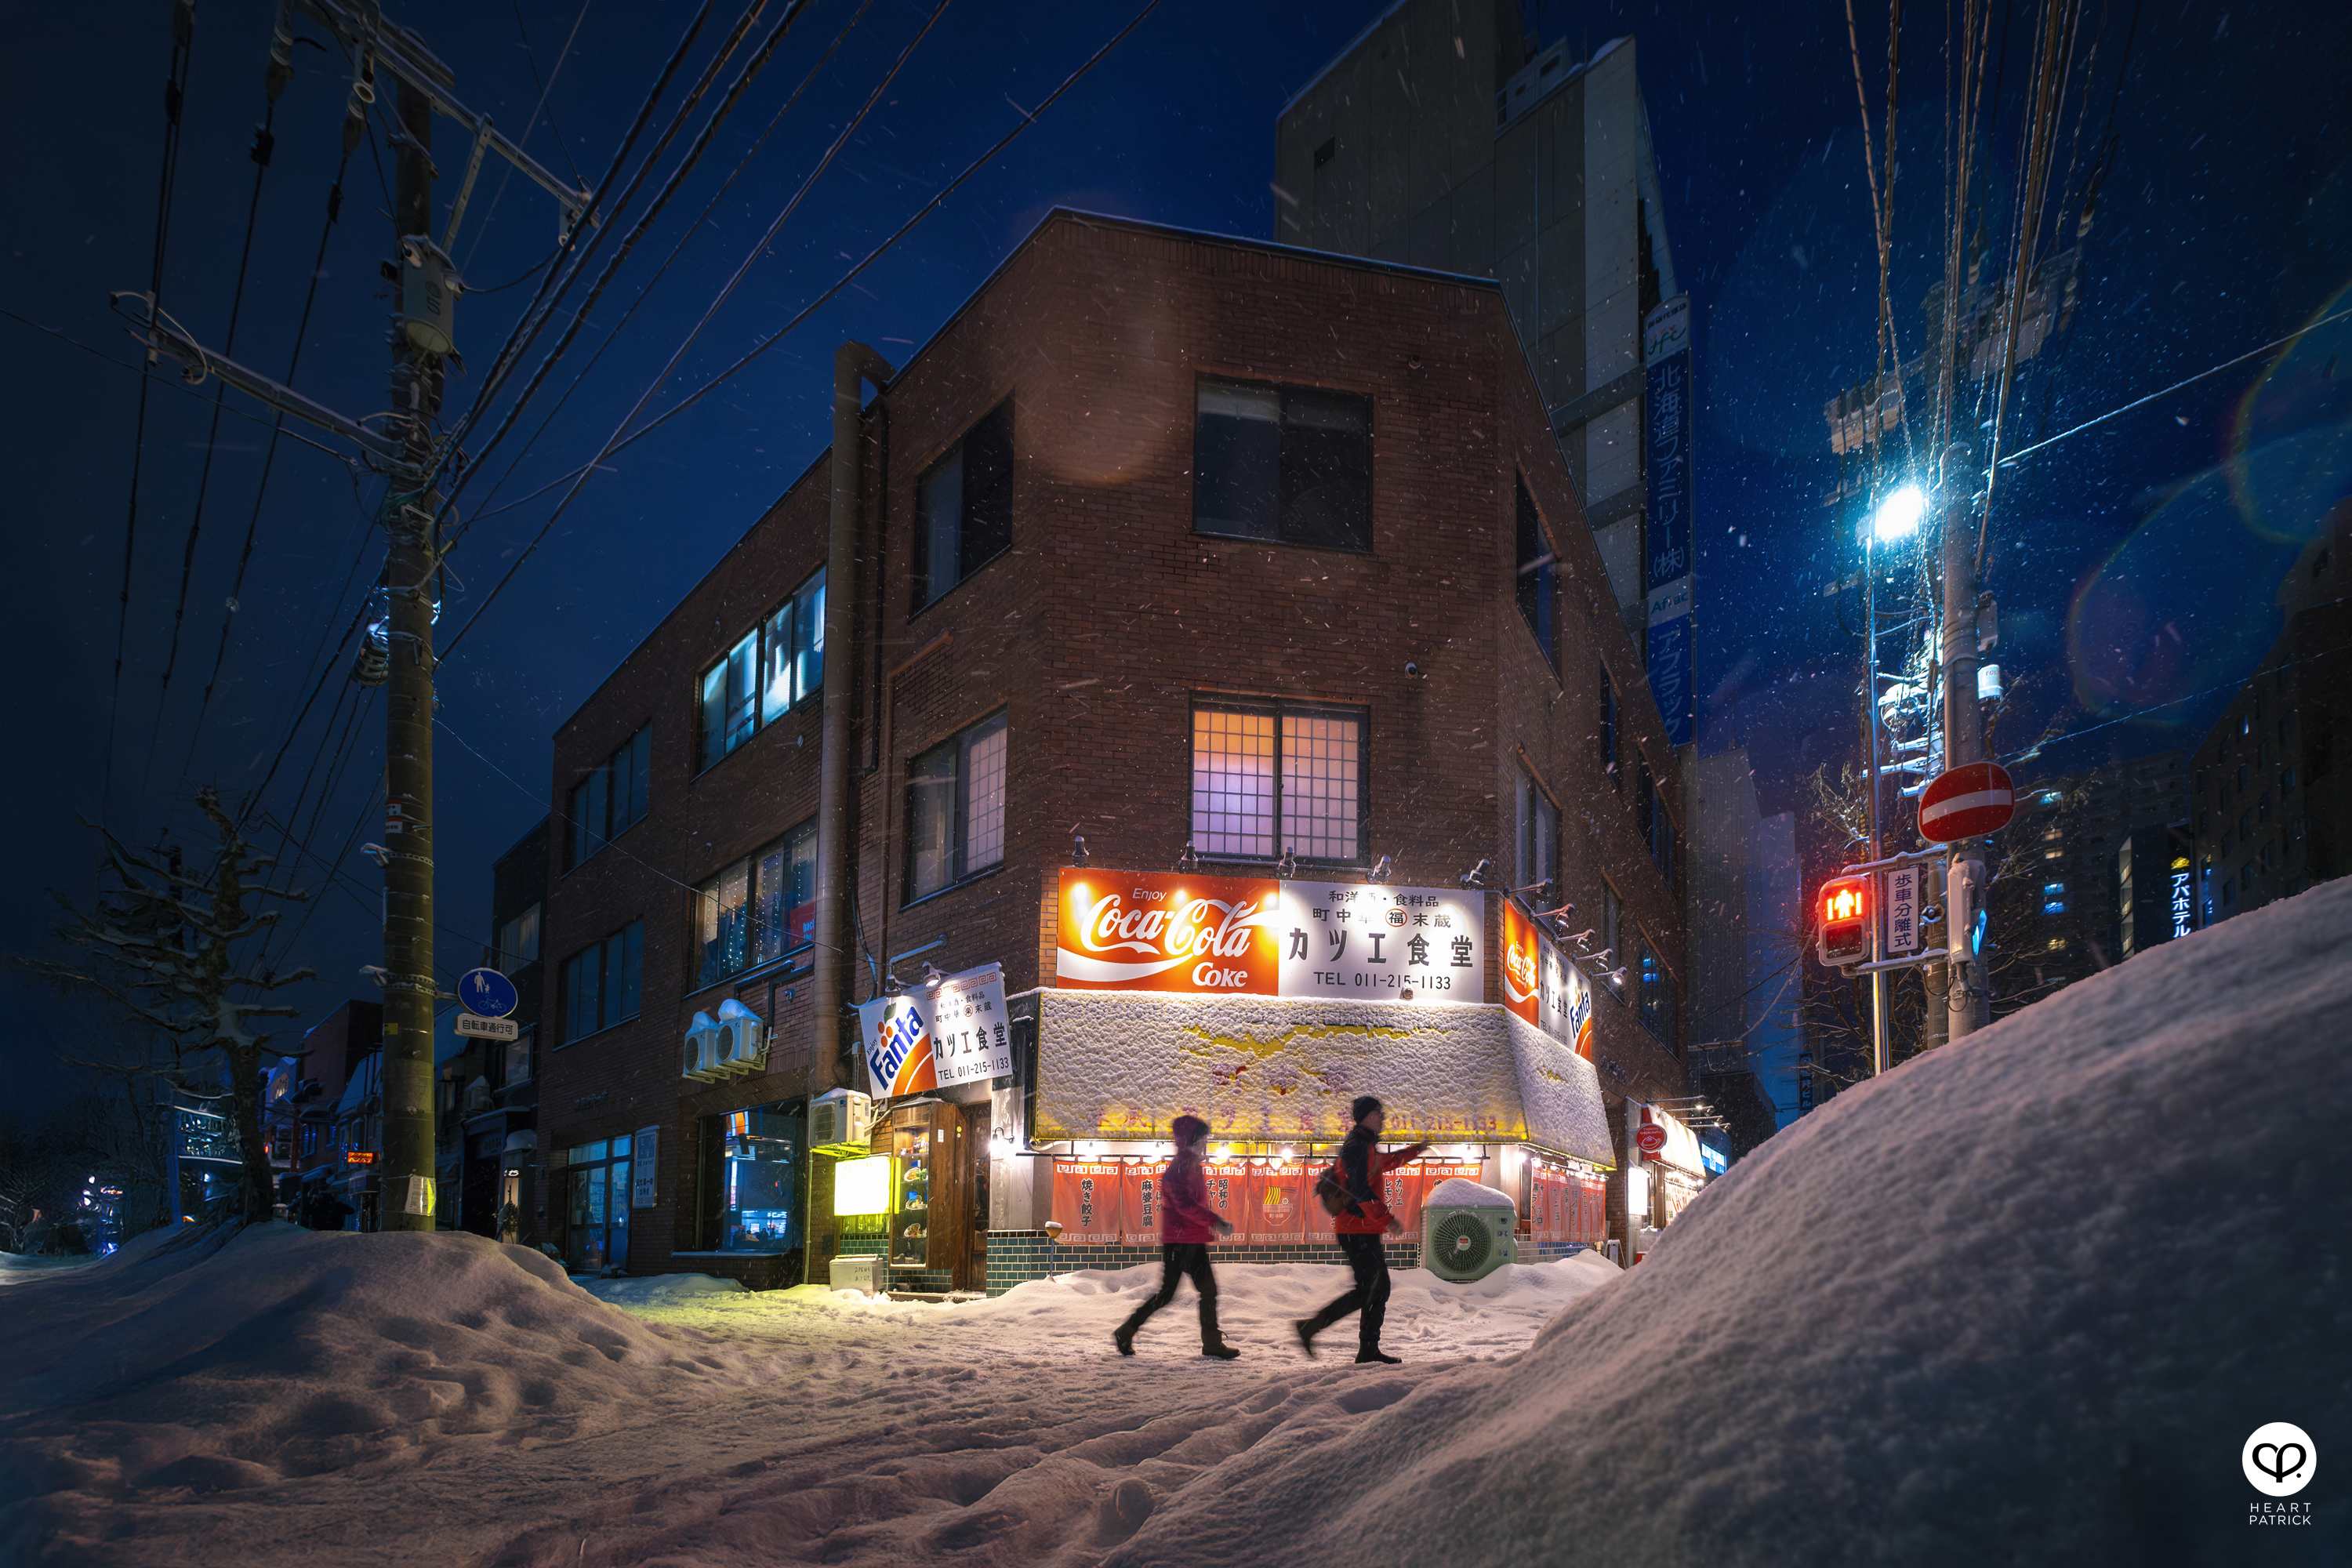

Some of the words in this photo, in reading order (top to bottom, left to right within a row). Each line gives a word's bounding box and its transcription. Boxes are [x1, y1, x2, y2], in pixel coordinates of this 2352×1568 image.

[1651, 590, 1688, 615] Aflac
[1132, 887, 1167, 901] Enjoy
[1893, 873, 1913, 948] 歩車分離式
[2171, 872, 2191, 938] アパホテル
[1080, 894, 1258, 957] Coca-Cola
[1288, 927, 1473, 967] カツエ食堂
[1507, 944, 1537, 988] Coca-Cola
[1192, 961, 1248, 987] Coke
[1313, 971, 1346, 985] TEL
[1355, 973, 1451, 989] 011-215-1133
[463, 1019, 514, 1034] 自転車通行可
[1570, 991, 1591, 1040] Fanta
[866, 1036, 878, 1056] Enjoy
[869, 1006, 924, 1091] Fanta
[933, 1022, 1007, 1061] カツエ食堂
[938, 1070, 955, 1081] TEL
[957, 1057, 1010, 1077] 011-215-1133
[1080, 1178, 1094, 1227] 焼き餃子
[1142, 1179, 1153, 1227] 麻婆豆腐
[1206, 1178, 1217, 1210] チャー
[1218, 1178, 1229, 1209] 昭和の
